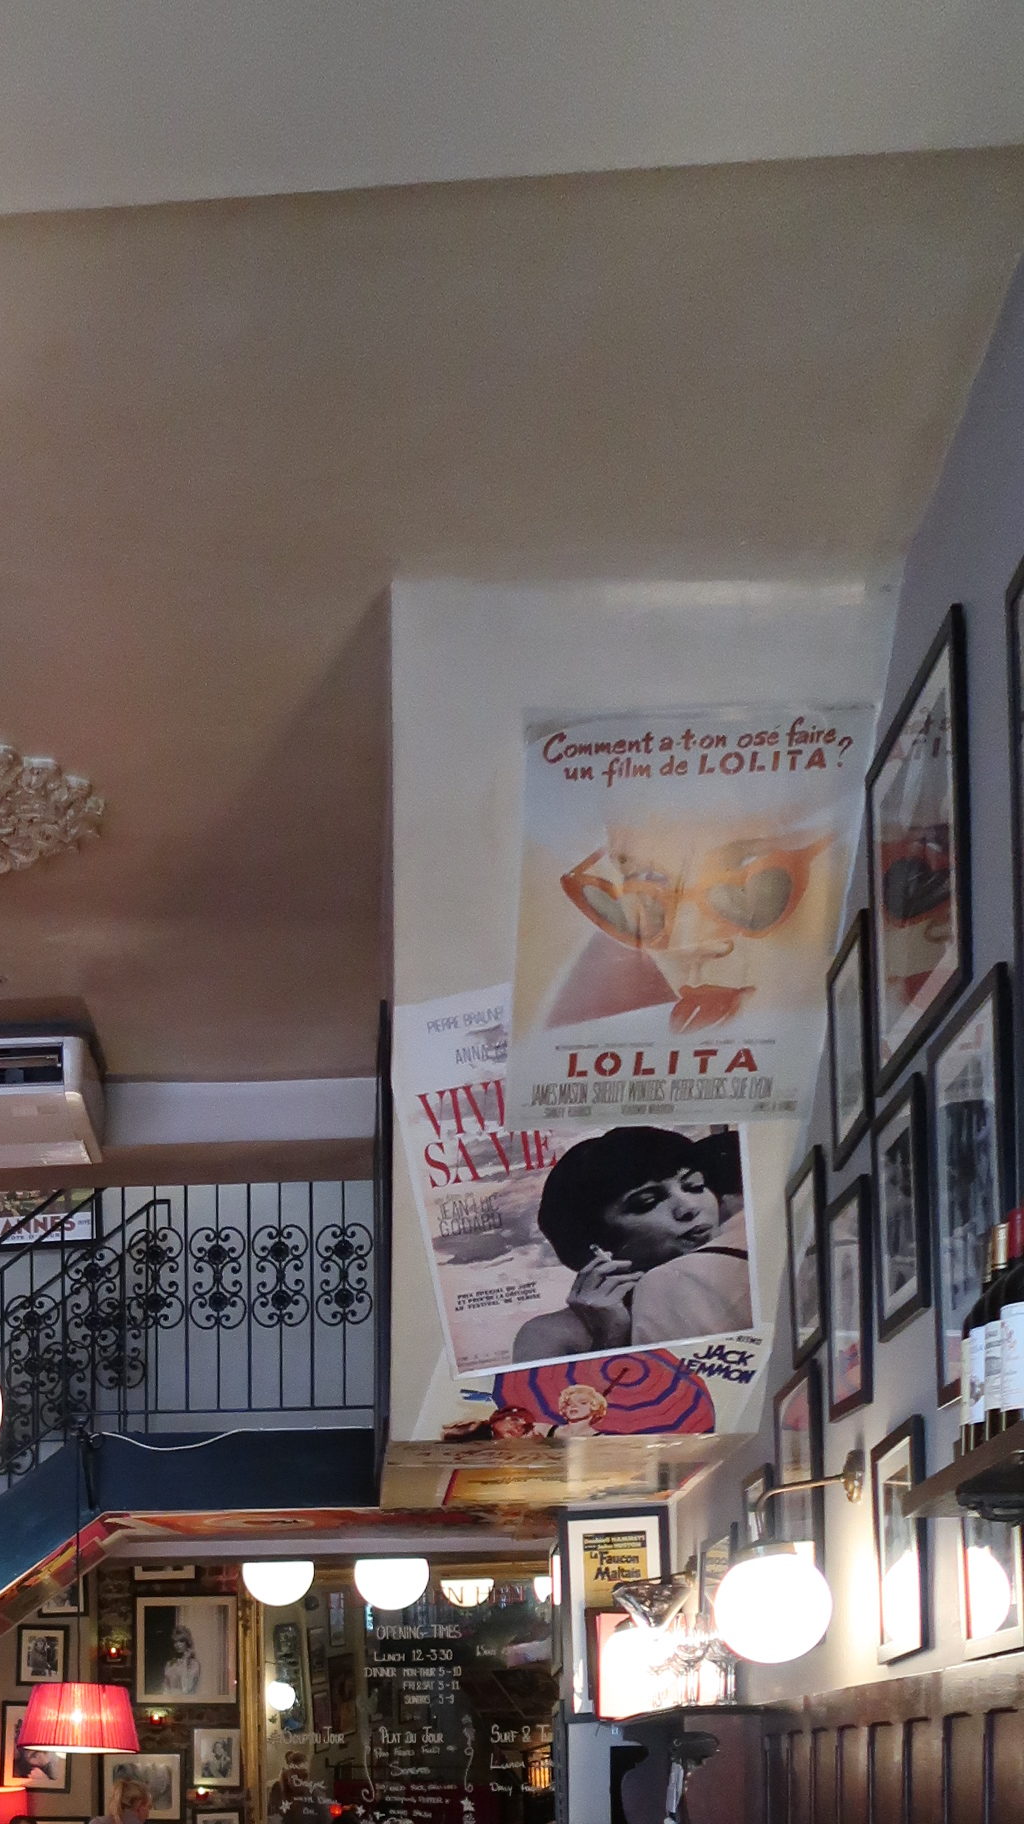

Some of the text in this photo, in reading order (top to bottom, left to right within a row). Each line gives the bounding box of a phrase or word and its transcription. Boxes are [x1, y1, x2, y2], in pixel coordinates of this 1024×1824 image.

[542, 731, 654, 764] Comment
[737, 724, 781, 749] osé
[563, 748, 827, 787] un film de LOLITA
[567, 1048, 758, 1078] LOLITA
[424, 1130, 558, 1188] SA VIE
[693, 1344, 755, 1367] JACK
[678, 1357, 757, 1384] LEMMON
[599, 1551, 640, 1566] Faucon
[376, 1623, 462, 1640] OPENING TIMES
[364, 1667, 397, 1678] DINNER
